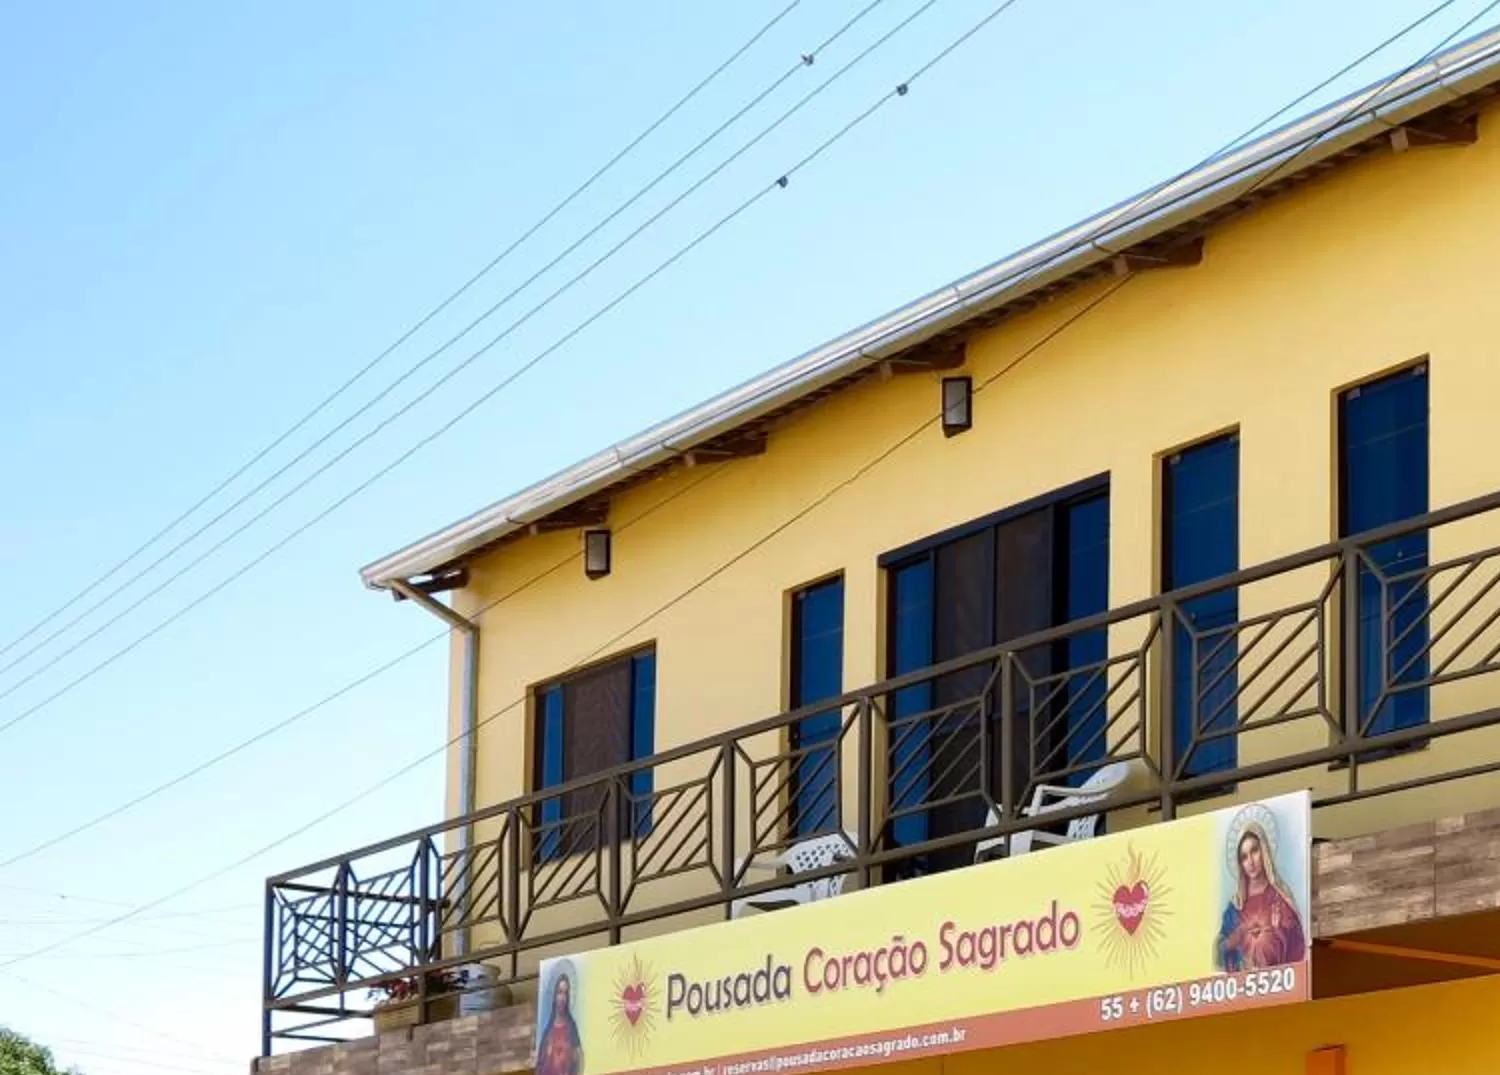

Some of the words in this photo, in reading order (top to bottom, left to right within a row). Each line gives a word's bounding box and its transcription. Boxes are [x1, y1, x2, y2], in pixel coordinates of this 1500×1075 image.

[666, 953, 792, 1020] Pousada
[803, 935, 928, 995] Coração
[938, 898, 1081, 971] Sagrado
[1101, 995, 1124, 1021] 55
[1146, 986, 1183, 1018] (62)
[1189, 966, 1296, 1006] 9400-5520
